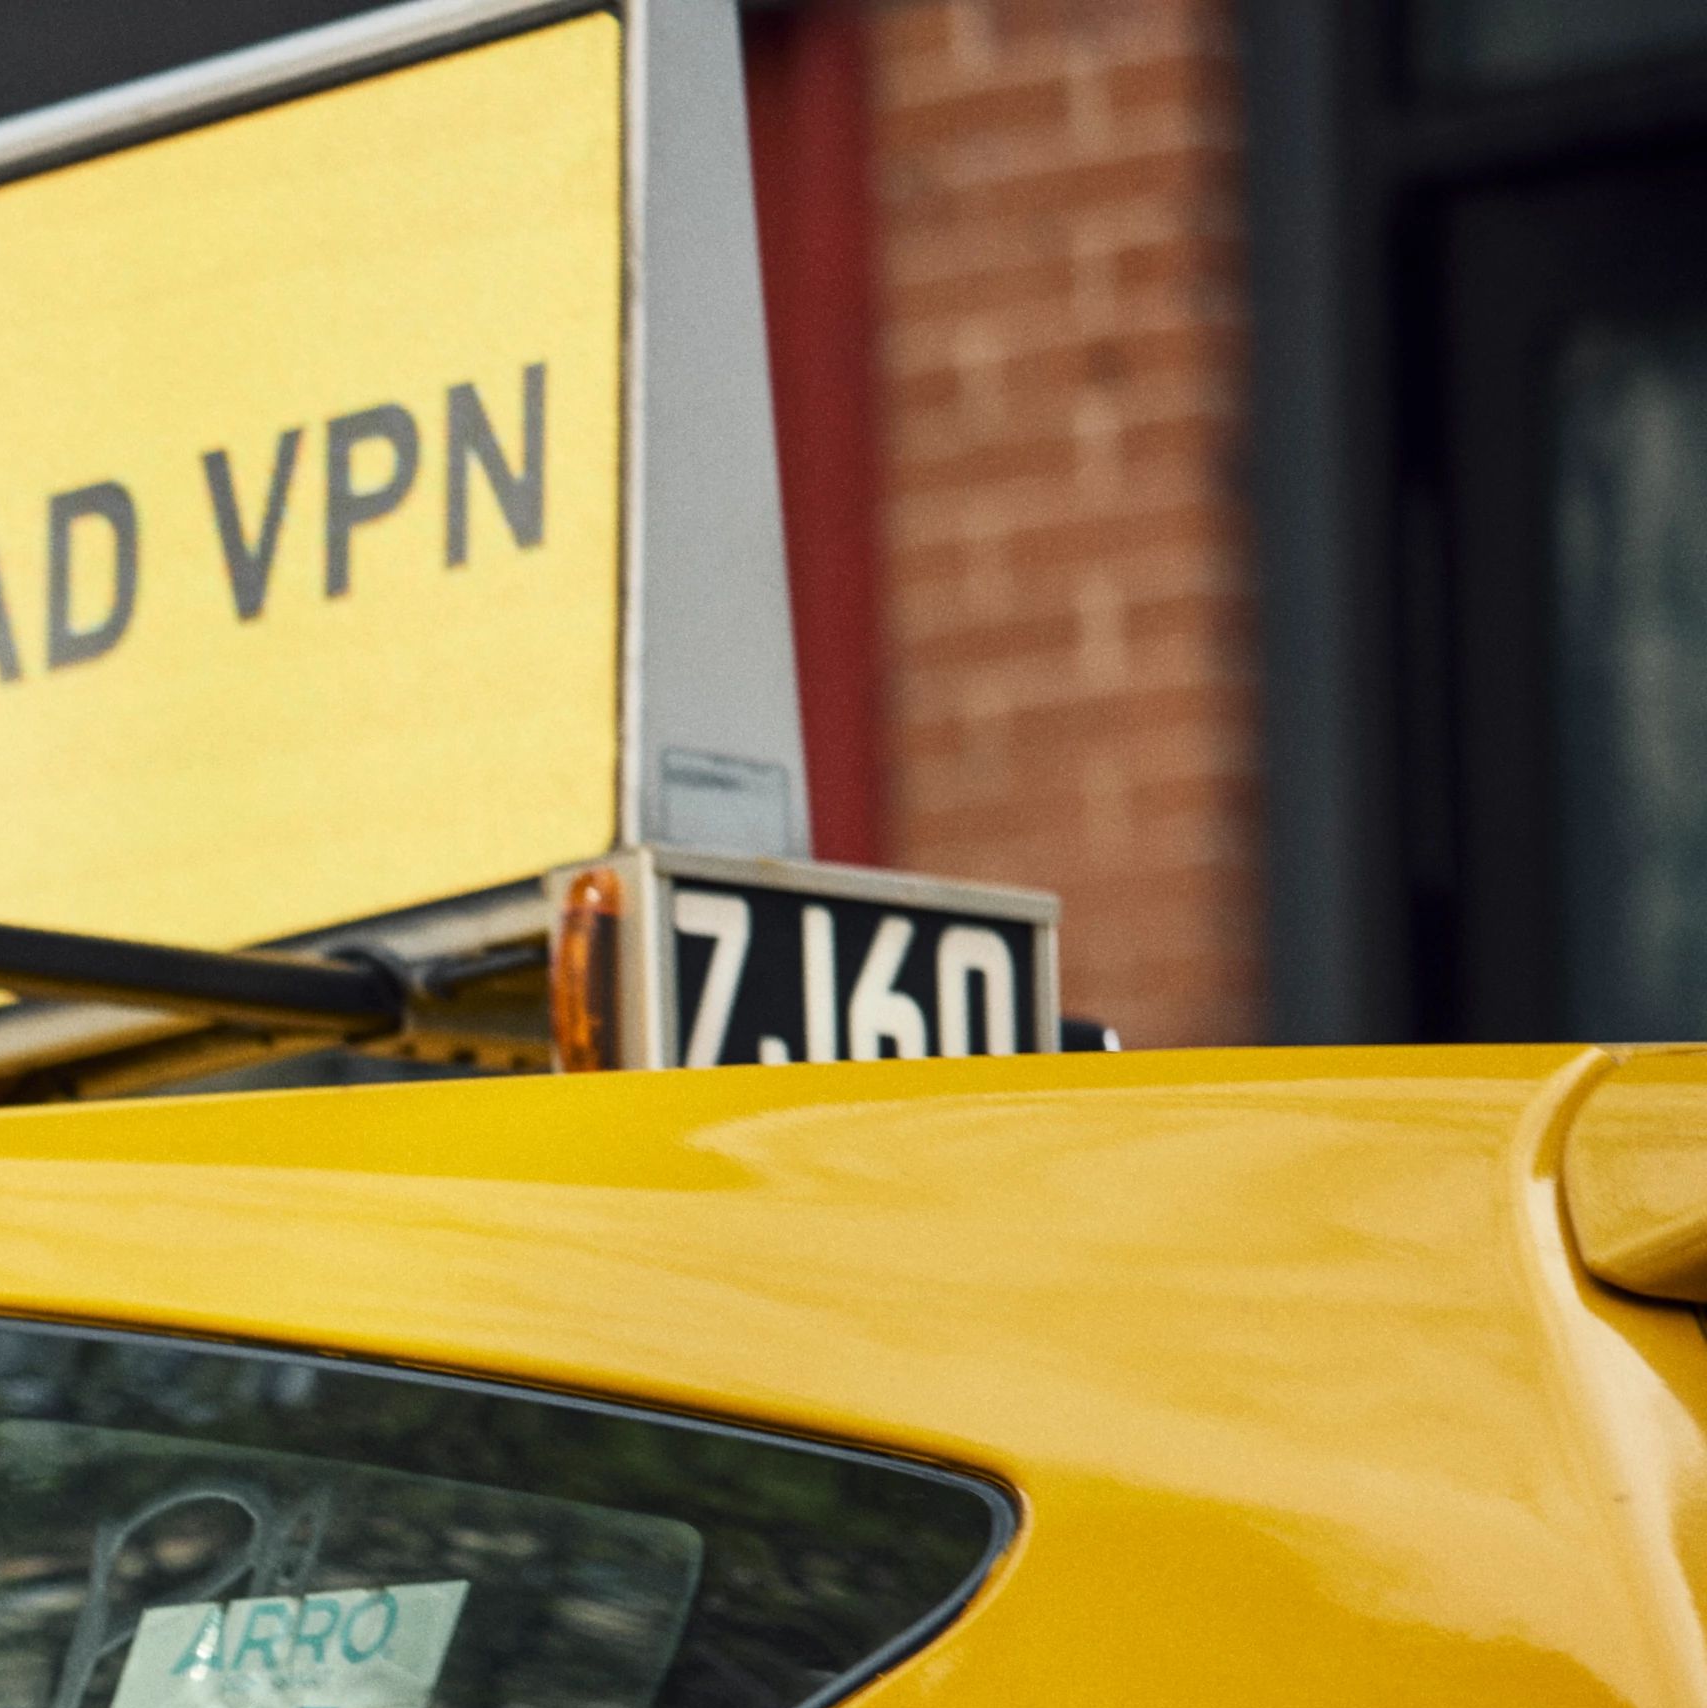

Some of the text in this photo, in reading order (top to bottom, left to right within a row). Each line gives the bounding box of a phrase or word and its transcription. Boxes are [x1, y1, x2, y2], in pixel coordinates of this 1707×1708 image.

[199, 361, 548, 624] VPN
[674, 893, 1017, 1066] 7J60
[172, 1590, 401, 1677] ARRO
